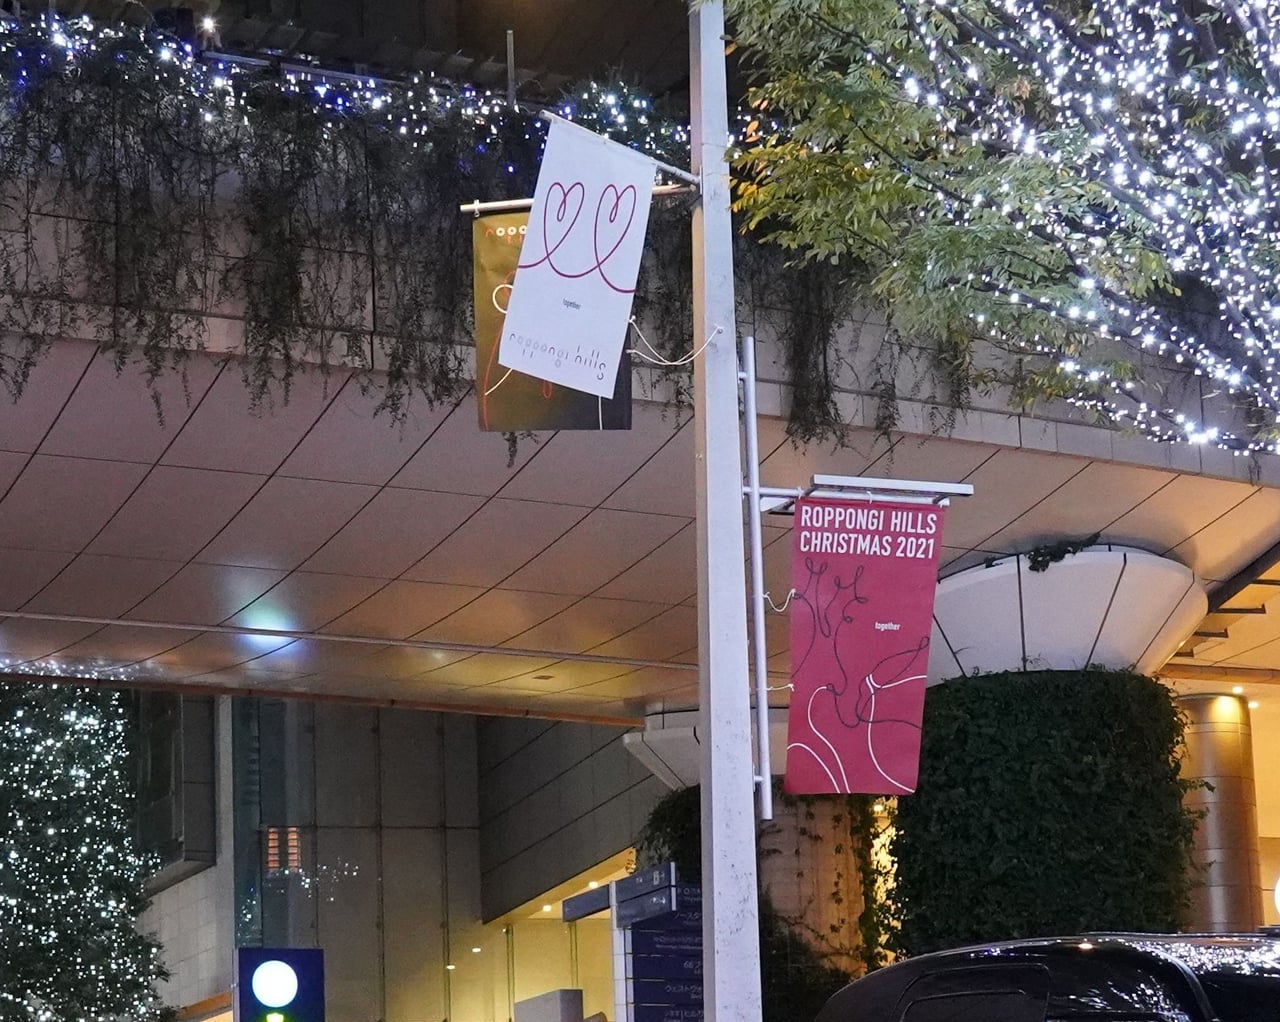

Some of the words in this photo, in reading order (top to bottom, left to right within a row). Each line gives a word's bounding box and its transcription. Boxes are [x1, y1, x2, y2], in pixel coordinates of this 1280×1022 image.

[801, 505, 884, 531] ROPPONGI
[890, 511, 938, 535] HILLS
[800, 531, 892, 556] CHRISTMAS
[895, 536, 935, 559] 2021
[874, 621, 901, 631] together
